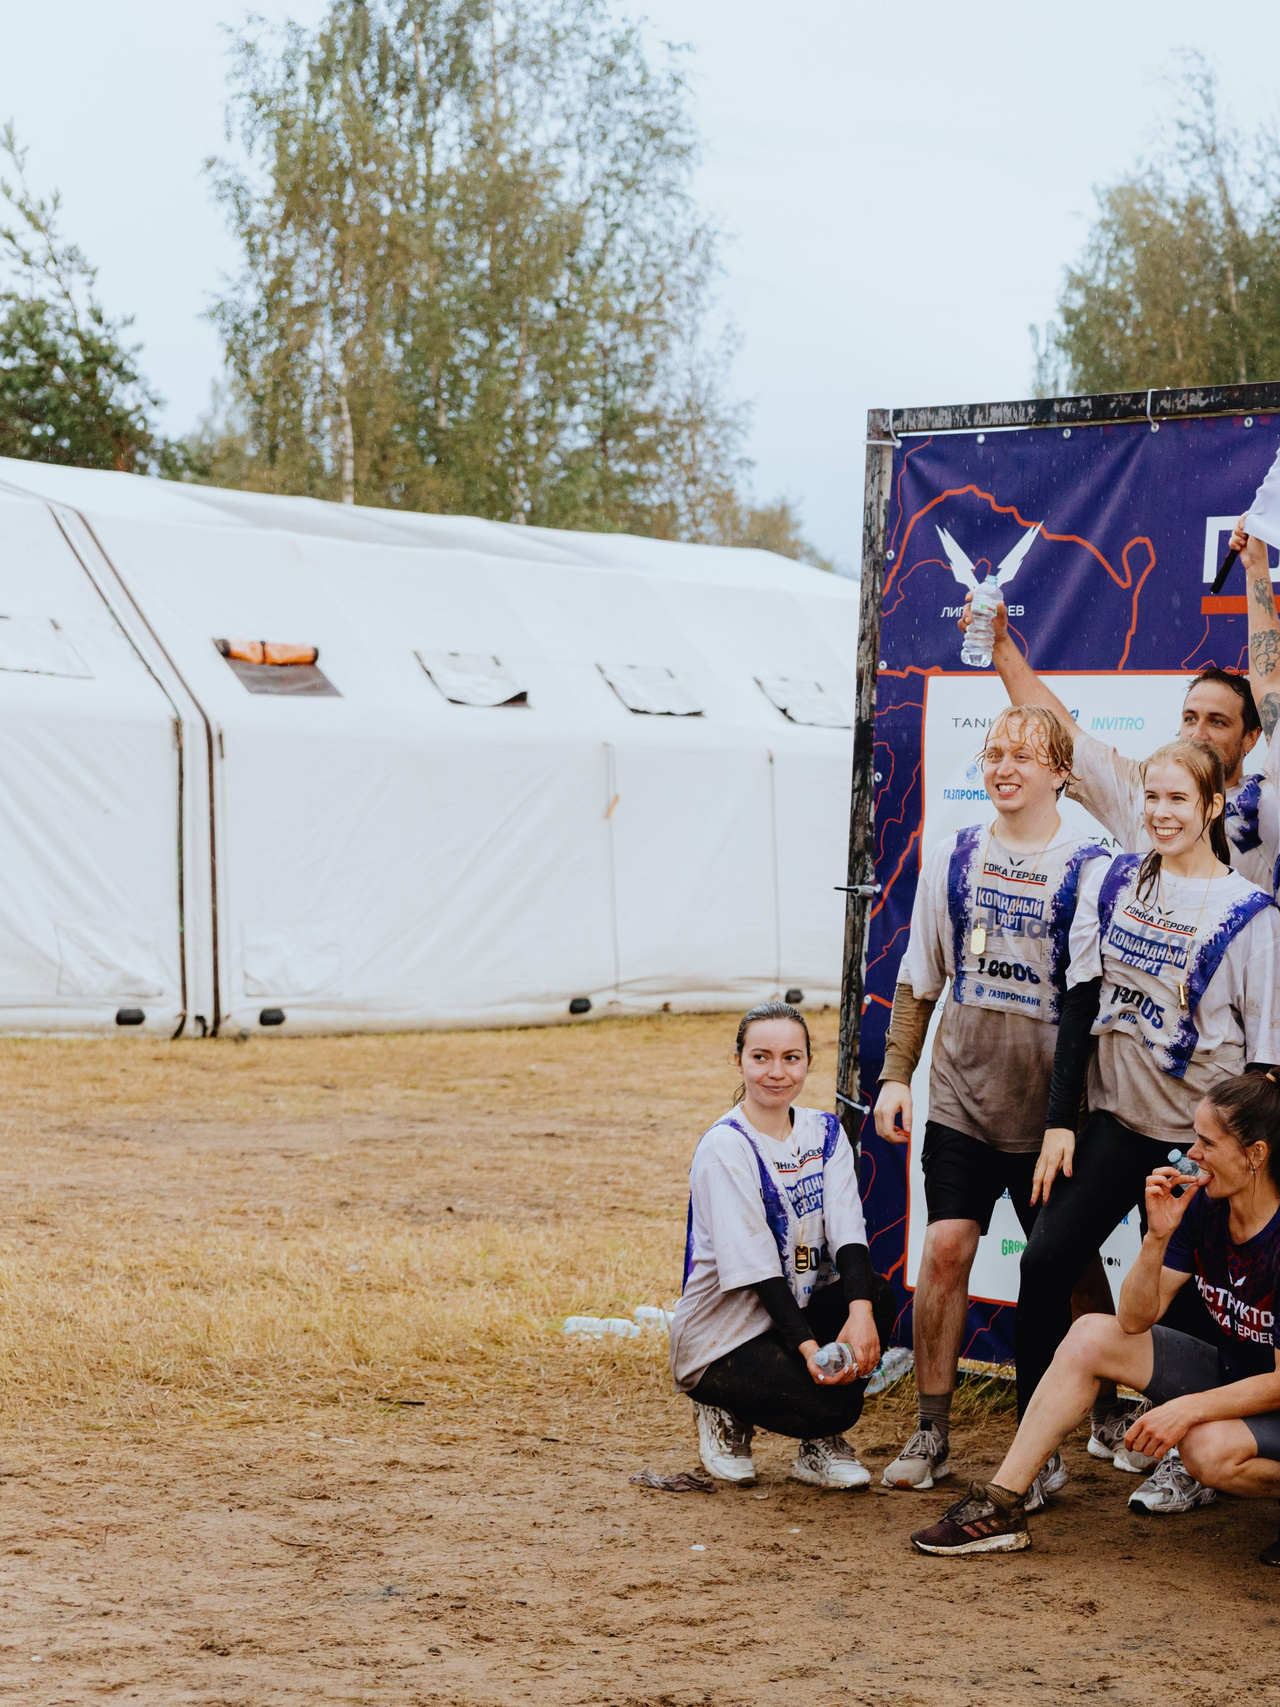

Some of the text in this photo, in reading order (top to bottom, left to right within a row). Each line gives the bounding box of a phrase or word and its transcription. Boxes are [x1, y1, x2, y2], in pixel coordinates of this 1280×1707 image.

[1091, 716, 1146, 732] INVITRO
[1110, 928, 1188, 966] КОМАНДНЫЙ
[988, 989, 1041, 1007] ГАЗПРОМБАНК
